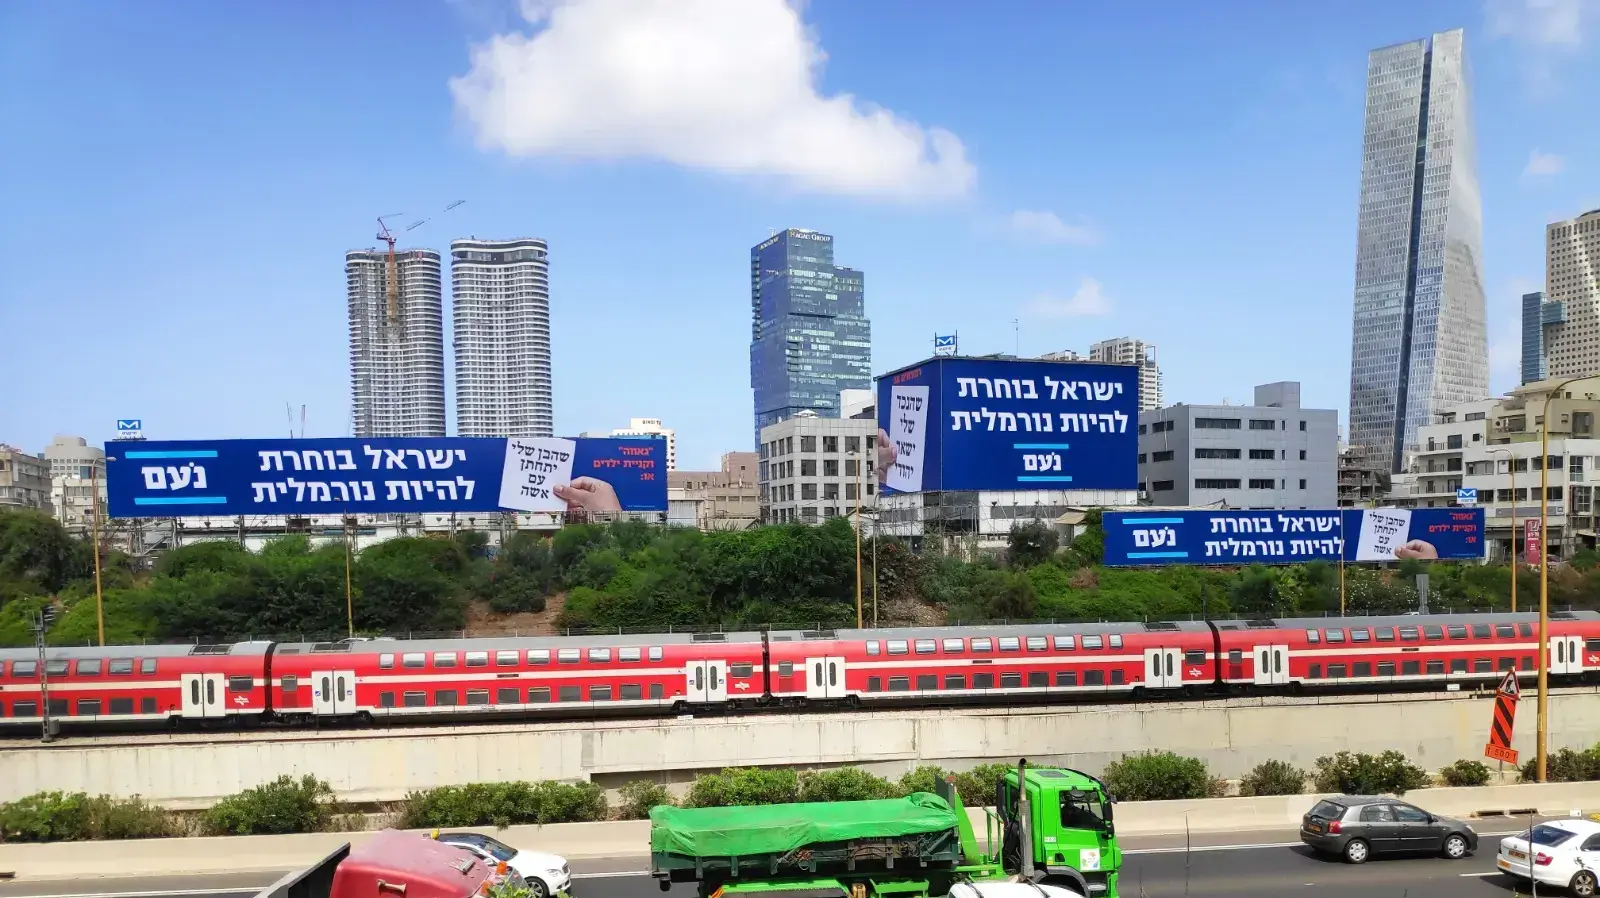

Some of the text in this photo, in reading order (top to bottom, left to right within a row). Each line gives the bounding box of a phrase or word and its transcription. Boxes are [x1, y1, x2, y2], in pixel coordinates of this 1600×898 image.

[957, 376, 1122, 400] ישראל בוחרת
[896, 394, 923, 412] שהנכד
[900, 413, 915, 434] שלי
[951, 408, 1128, 432] להיות נורמלית
[512, 441, 570, 464] שהבן שלי
[896, 440, 915, 456] ישאר
[258, 445, 466, 471] ישראל בוחרת
[520, 457, 558, 473] יתחתן
[593, 459, 655, 469] וקניית ילדים
[895, 461, 914, 479] יהודי
[529, 474, 545, 485] עם
[252, 476, 475, 502] להיות נורמלית
[521, 482, 549, 498] אשה
[1210, 515, 1340, 532] ישראל בוחרת
[1369, 511, 1406, 527] שהבן שלי
[1374, 524, 1398, 536] יתחתן
[1205, 537, 1344, 556] להיות נורמלית
[1378, 535, 1390, 545] עם
[1374, 544, 1392, 555] אשה
[1495, 749, 1510, 759] 500
